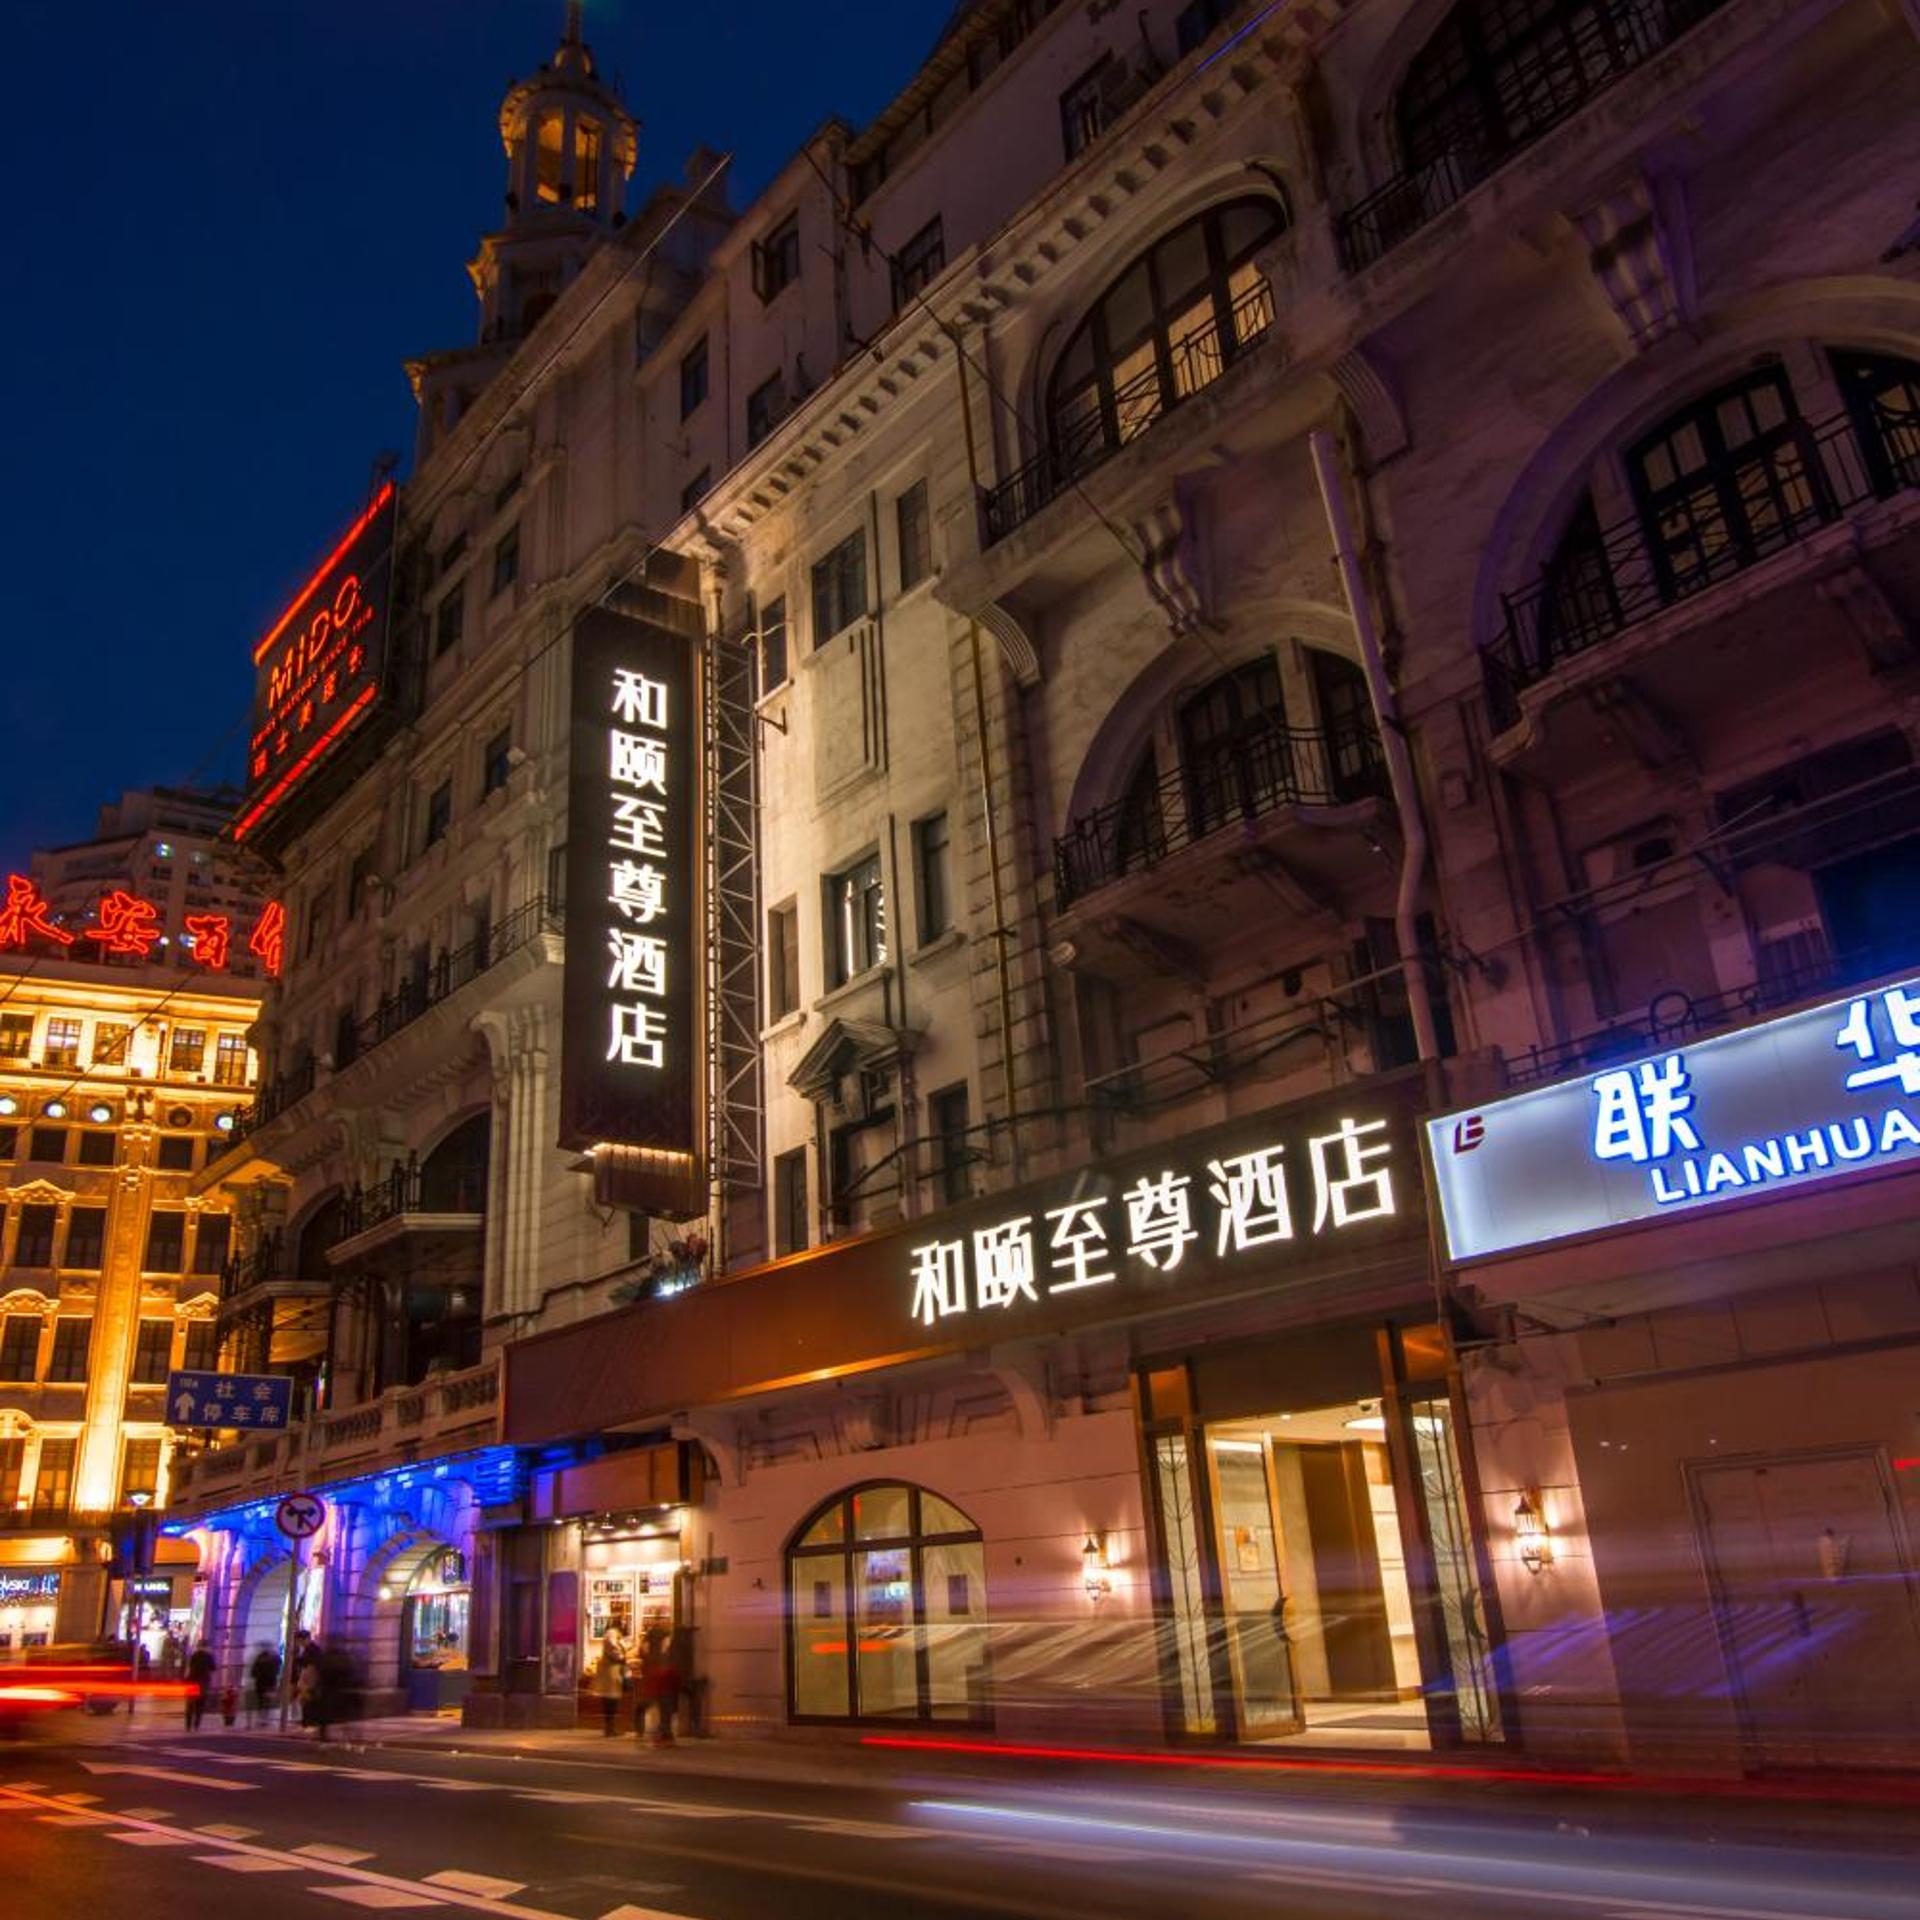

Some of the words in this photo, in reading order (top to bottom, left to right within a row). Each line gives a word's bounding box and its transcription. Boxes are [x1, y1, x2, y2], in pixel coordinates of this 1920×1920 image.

[269, 575, 358, 710] MIDO
[606, 668, 667, 1068] 和颐至尊酒店
[911, 1118, 1396, 1326] 和颐至尊酒店
[1652, 1108, 1920, 1204] LIANHUA
